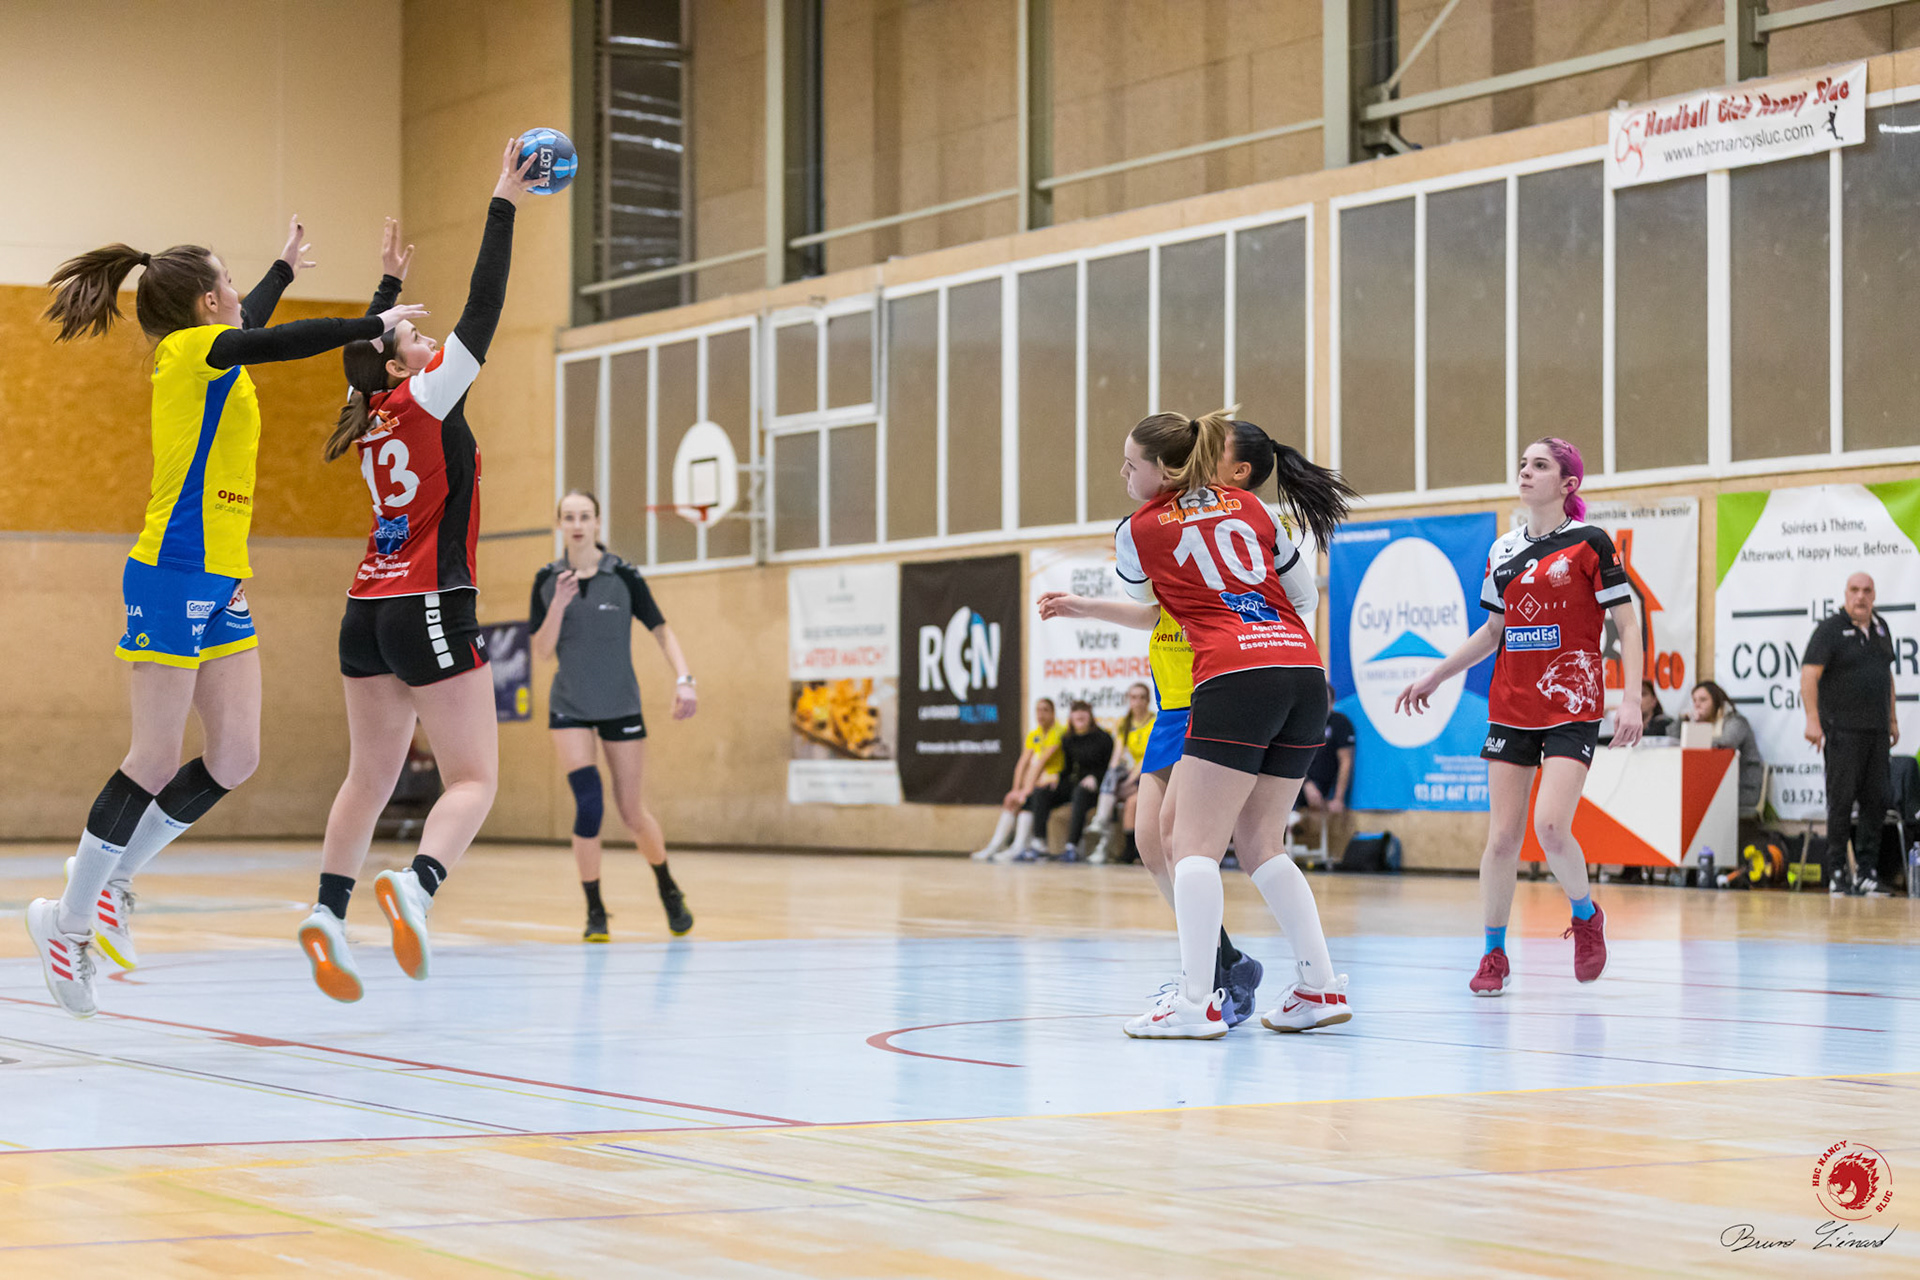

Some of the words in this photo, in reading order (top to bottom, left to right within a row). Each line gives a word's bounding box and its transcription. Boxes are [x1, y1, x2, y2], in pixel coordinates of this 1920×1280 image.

[1644, 100, 1710, 137] Handball
[1718, 96, 1753, 123] Club
[1757, 92, 1808, 117] Nancy
[1813, 77, 1850, 105] Sluc
[1663, 123, 1815, 163] www.hbcnancysluc.com
[361, 438, 421, 516] 13
[1781, 519, 1818, 536] Soirées
[1821, 519, 1827, 533] à
[1172, 518, 1267, 591] 10
[1740, 546, 1794, 562] Afterwork,
[1797, 545, 1831, 561] Happy
[1520, 558, 1538, 584] 2
[1357, 602, 1391, 635] Guy
[1396, 599, 1458, 630] Hoquet
[1812, 599, 1834, 622] LE
[1076, 629, 1120, 649] Votre
[1506, 628, 1540, 642] Grand
[1542, 627, 1558, 641] Est
